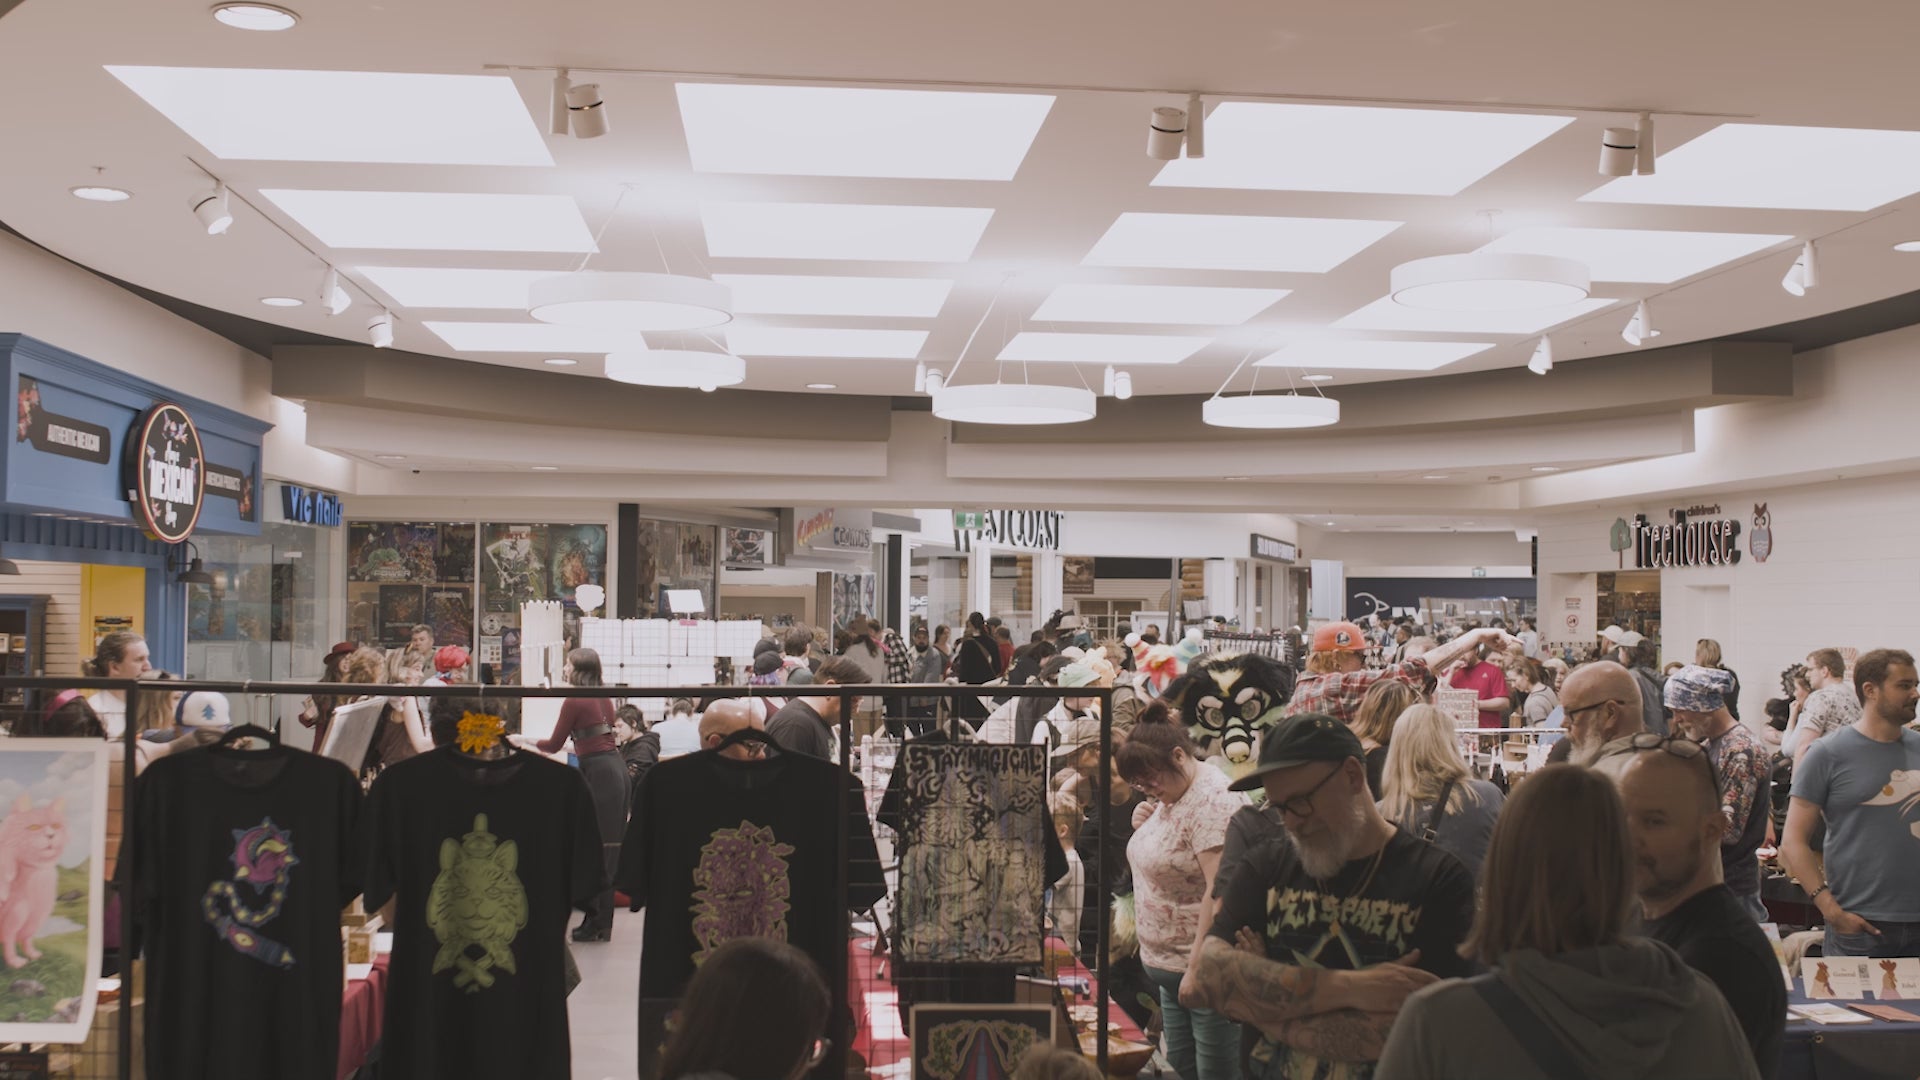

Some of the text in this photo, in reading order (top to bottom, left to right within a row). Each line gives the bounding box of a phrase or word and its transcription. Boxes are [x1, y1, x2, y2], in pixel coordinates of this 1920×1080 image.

[150, 459, 194, 505] MEXICAN
[287, 484, 312, 524] Vic
[1006, 510, 1064, 550] COAST
[1631, 512, 1740, 568] treehouse
[909, 746, 1041, 776] STAY MAGICAL
